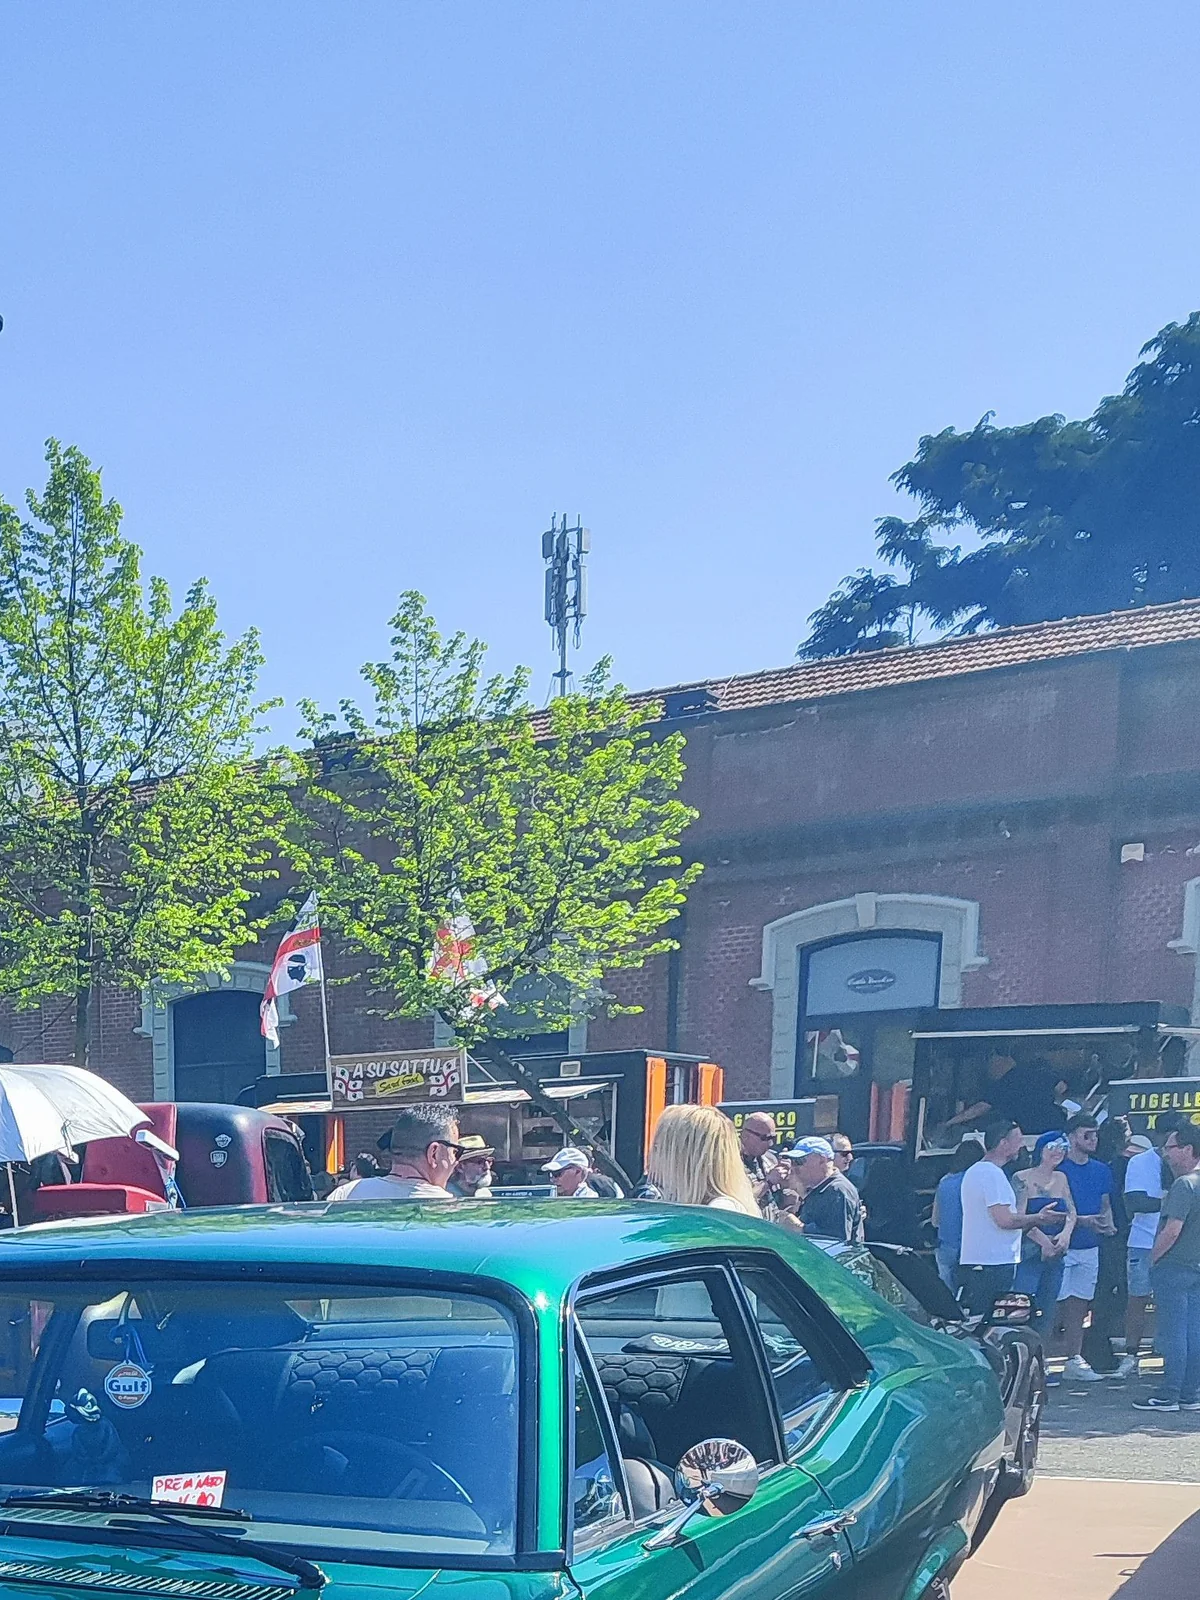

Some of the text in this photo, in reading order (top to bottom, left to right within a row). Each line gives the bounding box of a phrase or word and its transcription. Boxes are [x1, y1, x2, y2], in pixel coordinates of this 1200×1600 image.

[353, 1058, 440, 1078] A SU SATTU
[108, 1380, 148, 1392] Gulf
